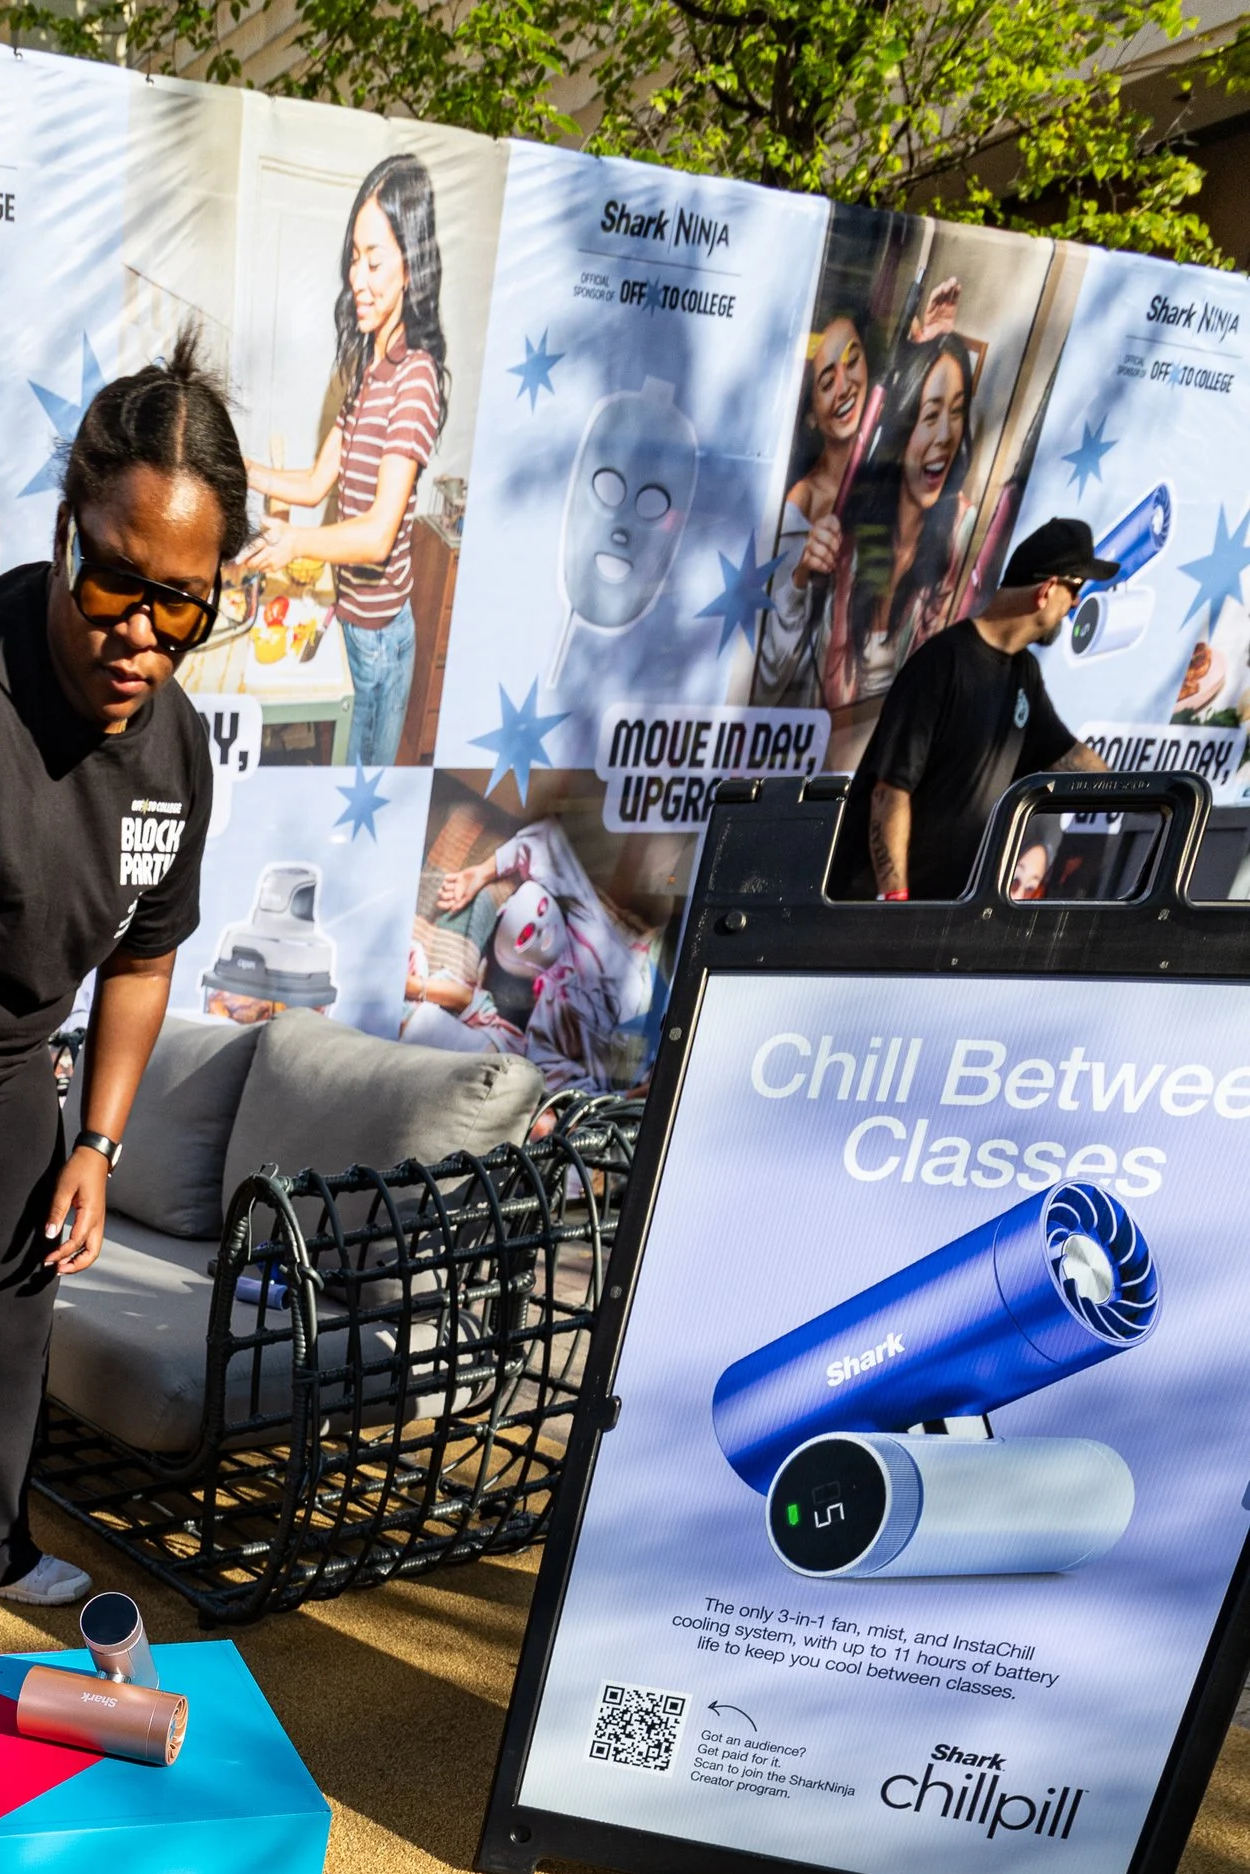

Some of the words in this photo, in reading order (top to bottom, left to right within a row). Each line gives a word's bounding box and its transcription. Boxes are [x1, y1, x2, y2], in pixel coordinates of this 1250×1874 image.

[601, 200, 669, 241] Shark
[674, 207, 729, 258] NINJA
[620, 279, 647, 305] OFF
[661, 285, 680, 310] TO
[681, 288, 736, 318] COLLEGE
[1147, 294, 1197, 328] Shark
[1197, 301, 1240, 343] NINJA
[1150, 361, 1172, 381] OFF
[1179, 366, 1194, 386] TO
[1194, 369, 1235, 393] COLLEGE
[712, 722, 747, 769] IN
[747, 723, 816, 775] DAY,
[121, 817, 186, 852] BLOCK
[120, 853, 176, 885] PARTY
[750, 1032, 924, 1103] Chill
[843, 1115, 1167, 1197] Classes
[825, 1332, 905, 1387] Shark
[705, 1597, 734, 1615] The
[739, 1604, 774, 1624] only
[778, 1609, 825, 1629] 3-in-1
[831, 1617, 862, 1636] fan,
[867, 1624, 908, 1644] mist,
[914, 1630, 948, 1649] and
[953, 1635, 1036, 1661] InstaChill
[672, 1615, 730, 1636] cooling
[735, 1624, 797, 1647] system,
[804, 1634, 837, 1651] with
[842, 1641, 865, 1658] up
[870, 1641, 887, 1658] to
[894, 1647, 910, 1662] 11
[916, 1651, 967, 1671] hours
[971, 1660, 992, 1675] of
[994, 1663, 1059, 1688] battery
[697, 1636, 721, 1652] life
[724, 1640, 741, 1655] to
[745, 1644, 785, 1666] keep
[789, 1653, 821, 1669] you
[825, 1658, 862, 1675] cool
[866, 1664, 941, 1688] between
[946, 1676, 1016, 1700] classes.
[81, 1691, 119, 1708] Shark
[698, 1744, 718, 1756] Get
[722, 1749, 748, 1762] paid
[752, 1753, 768, 1765] for
[771, 1756, 781, 1768] it.
[701, 1730, 722, 1742] Got
[726, 1736, 740, 1746] an
[744, 1739, 806, 1757] audience?
[930, 1744, 1007, 1771] Shark
[691, 1771, 734, 1787] Creator
[736, 1781, 790, 1799] program.
[694, 1757, 723, 1771] Scan
[728, 1763, 739, 1774] to
[741, 1766, 763, 1779] join
[767, 1771, 786, 1783] the
[790, 1775, 856, 1797] SharkNinja
[880, 1763, 1084, 1839] chillpill
